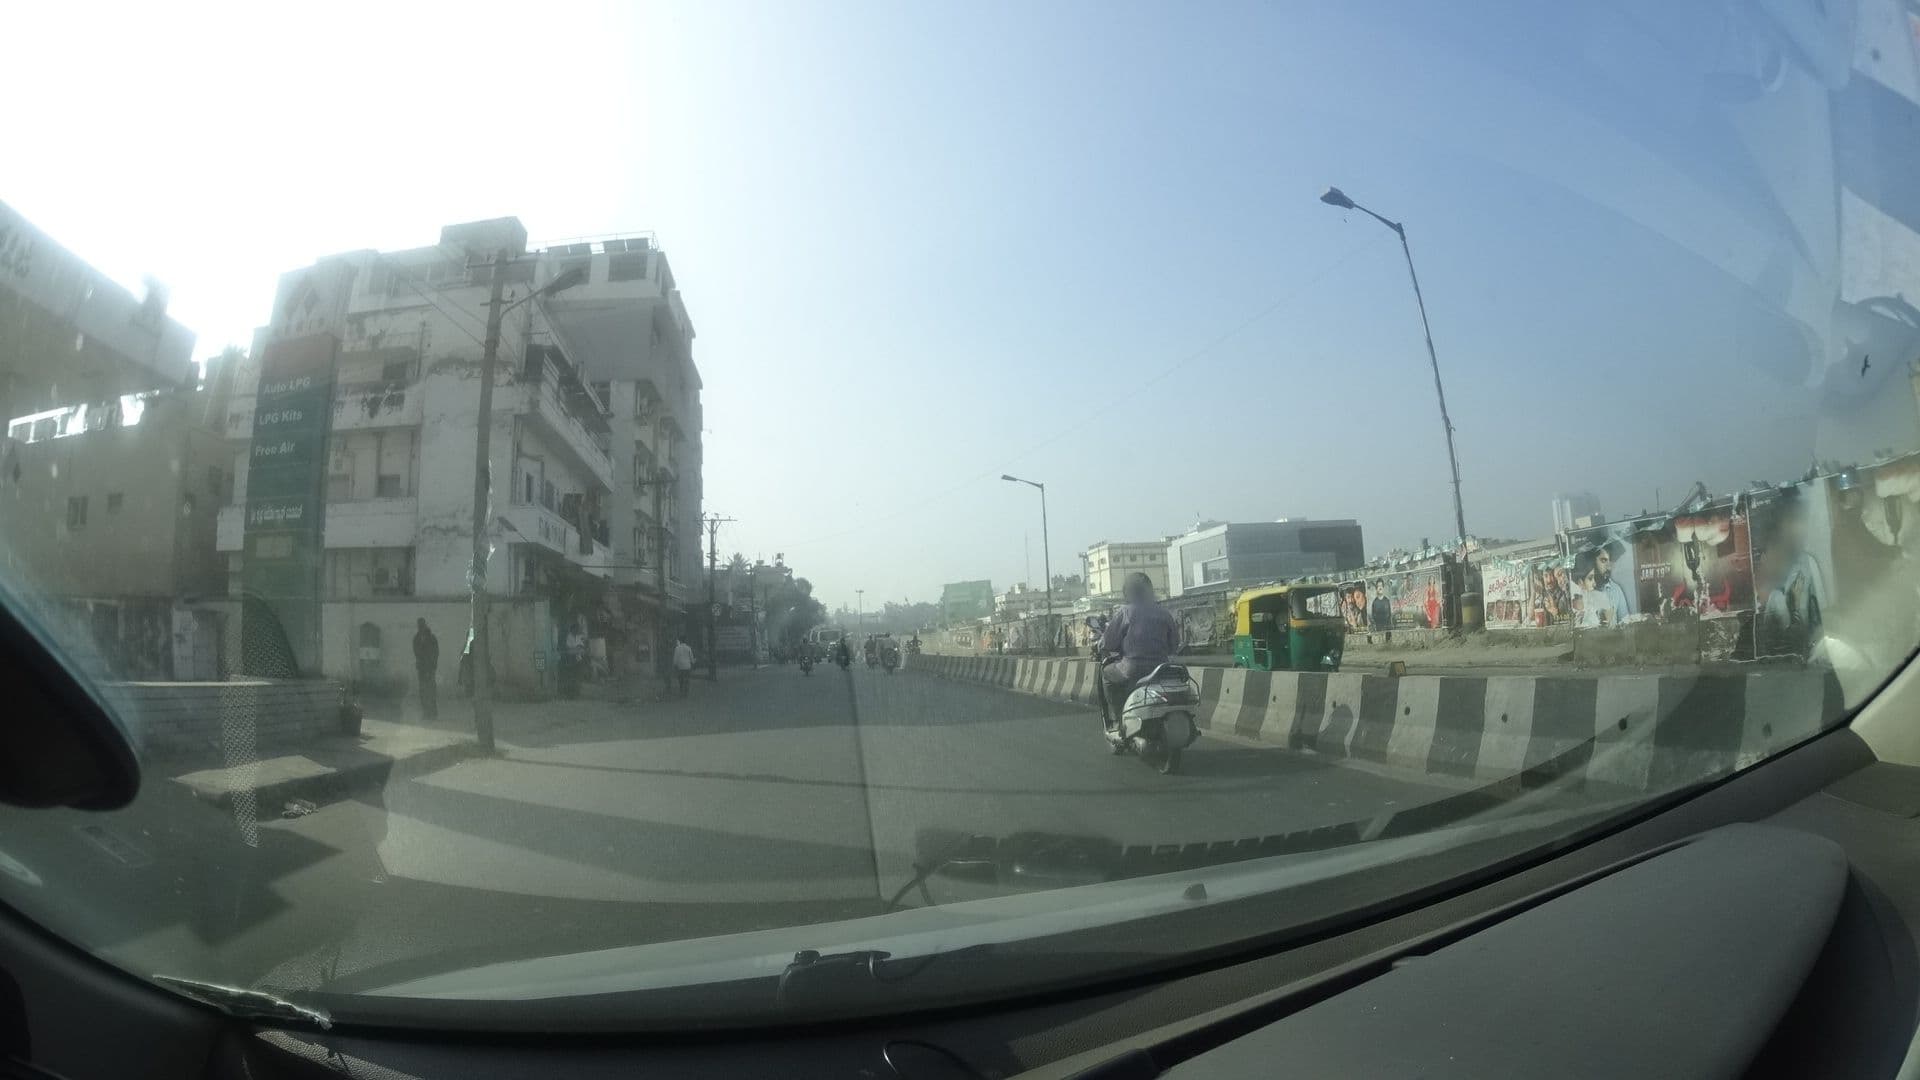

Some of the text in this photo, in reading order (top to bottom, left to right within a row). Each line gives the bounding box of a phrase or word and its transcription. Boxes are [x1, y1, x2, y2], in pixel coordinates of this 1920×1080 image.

[289, 376, 311, 391] LPG
[259, 411, 280, 426] LPG
[280, 442, 295, 455] Air
